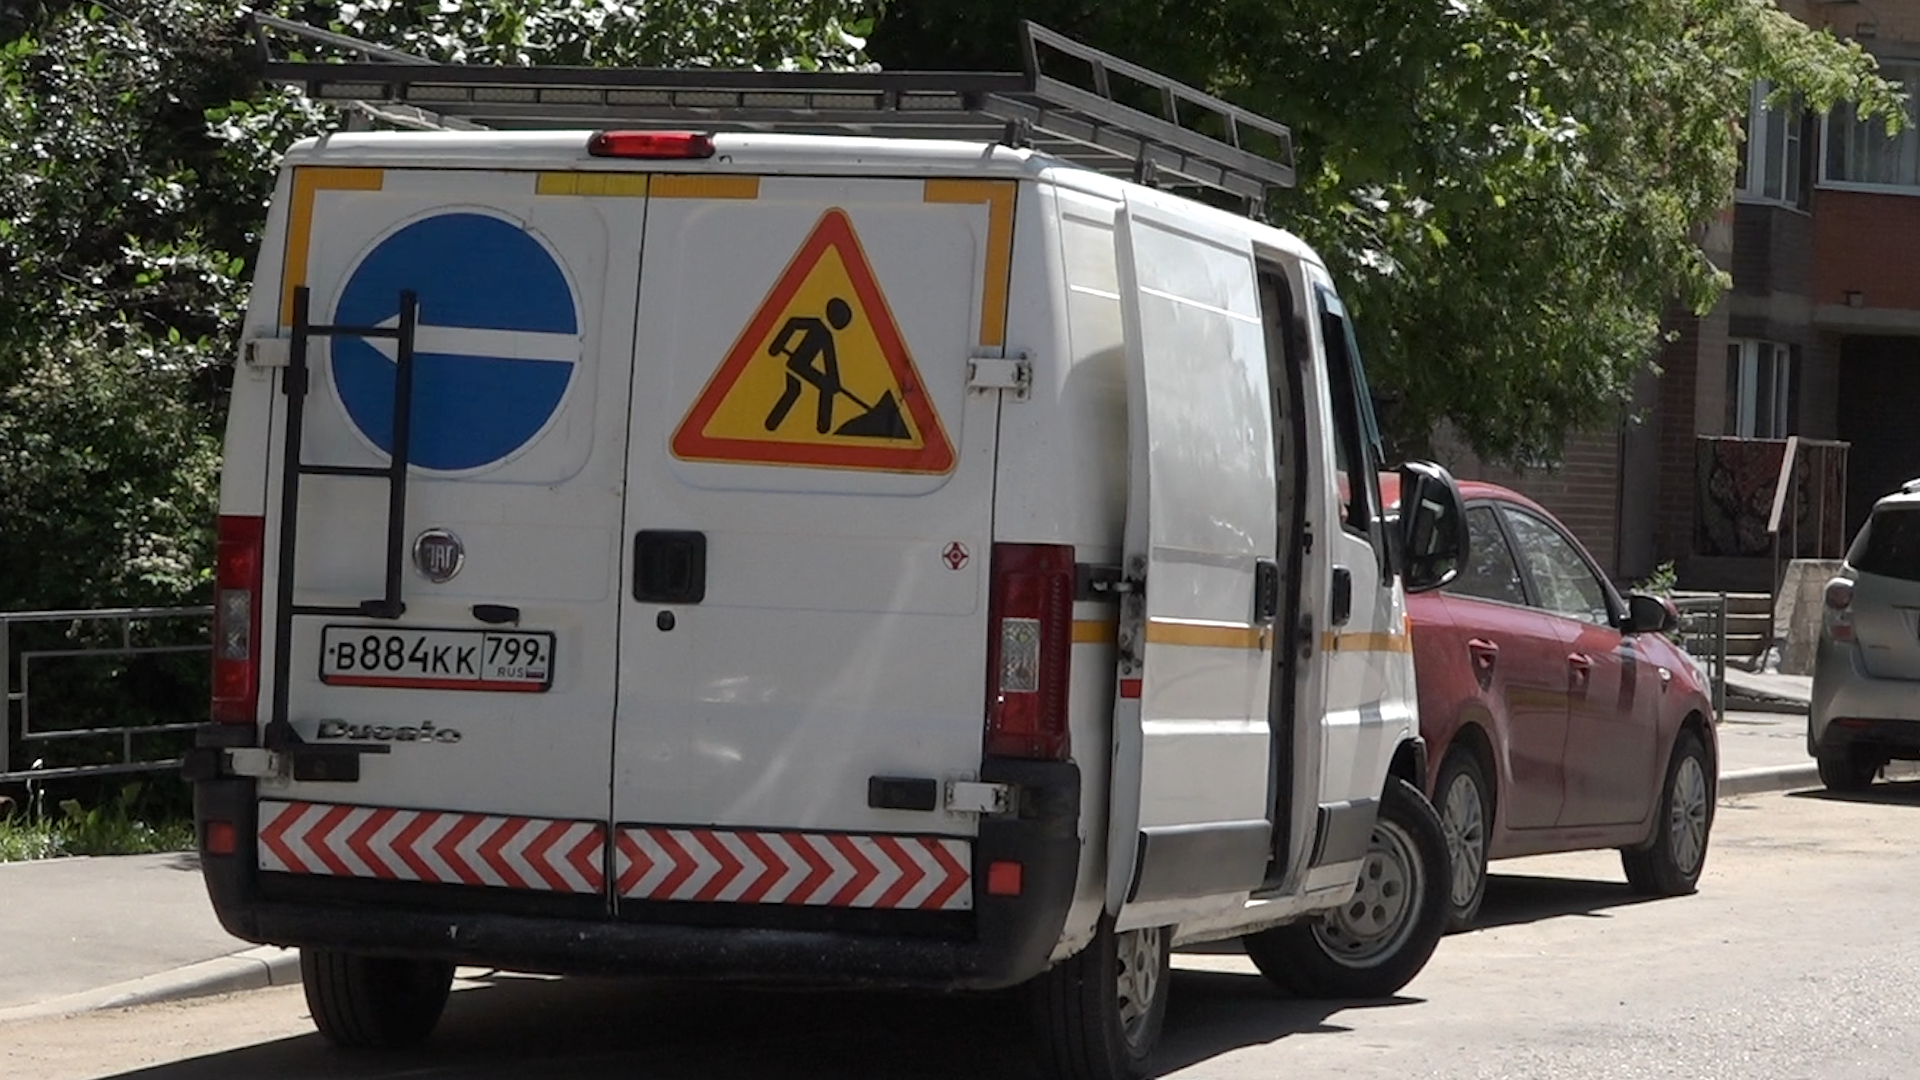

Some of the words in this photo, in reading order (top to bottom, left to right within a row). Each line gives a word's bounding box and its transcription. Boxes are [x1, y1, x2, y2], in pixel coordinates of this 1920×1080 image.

[336, 635, 477, 675] В884КК
[486, 637, 540, 666] 799
[497, 667, 524, 678] RUS
[316, 718, 462, 744] Ducato
